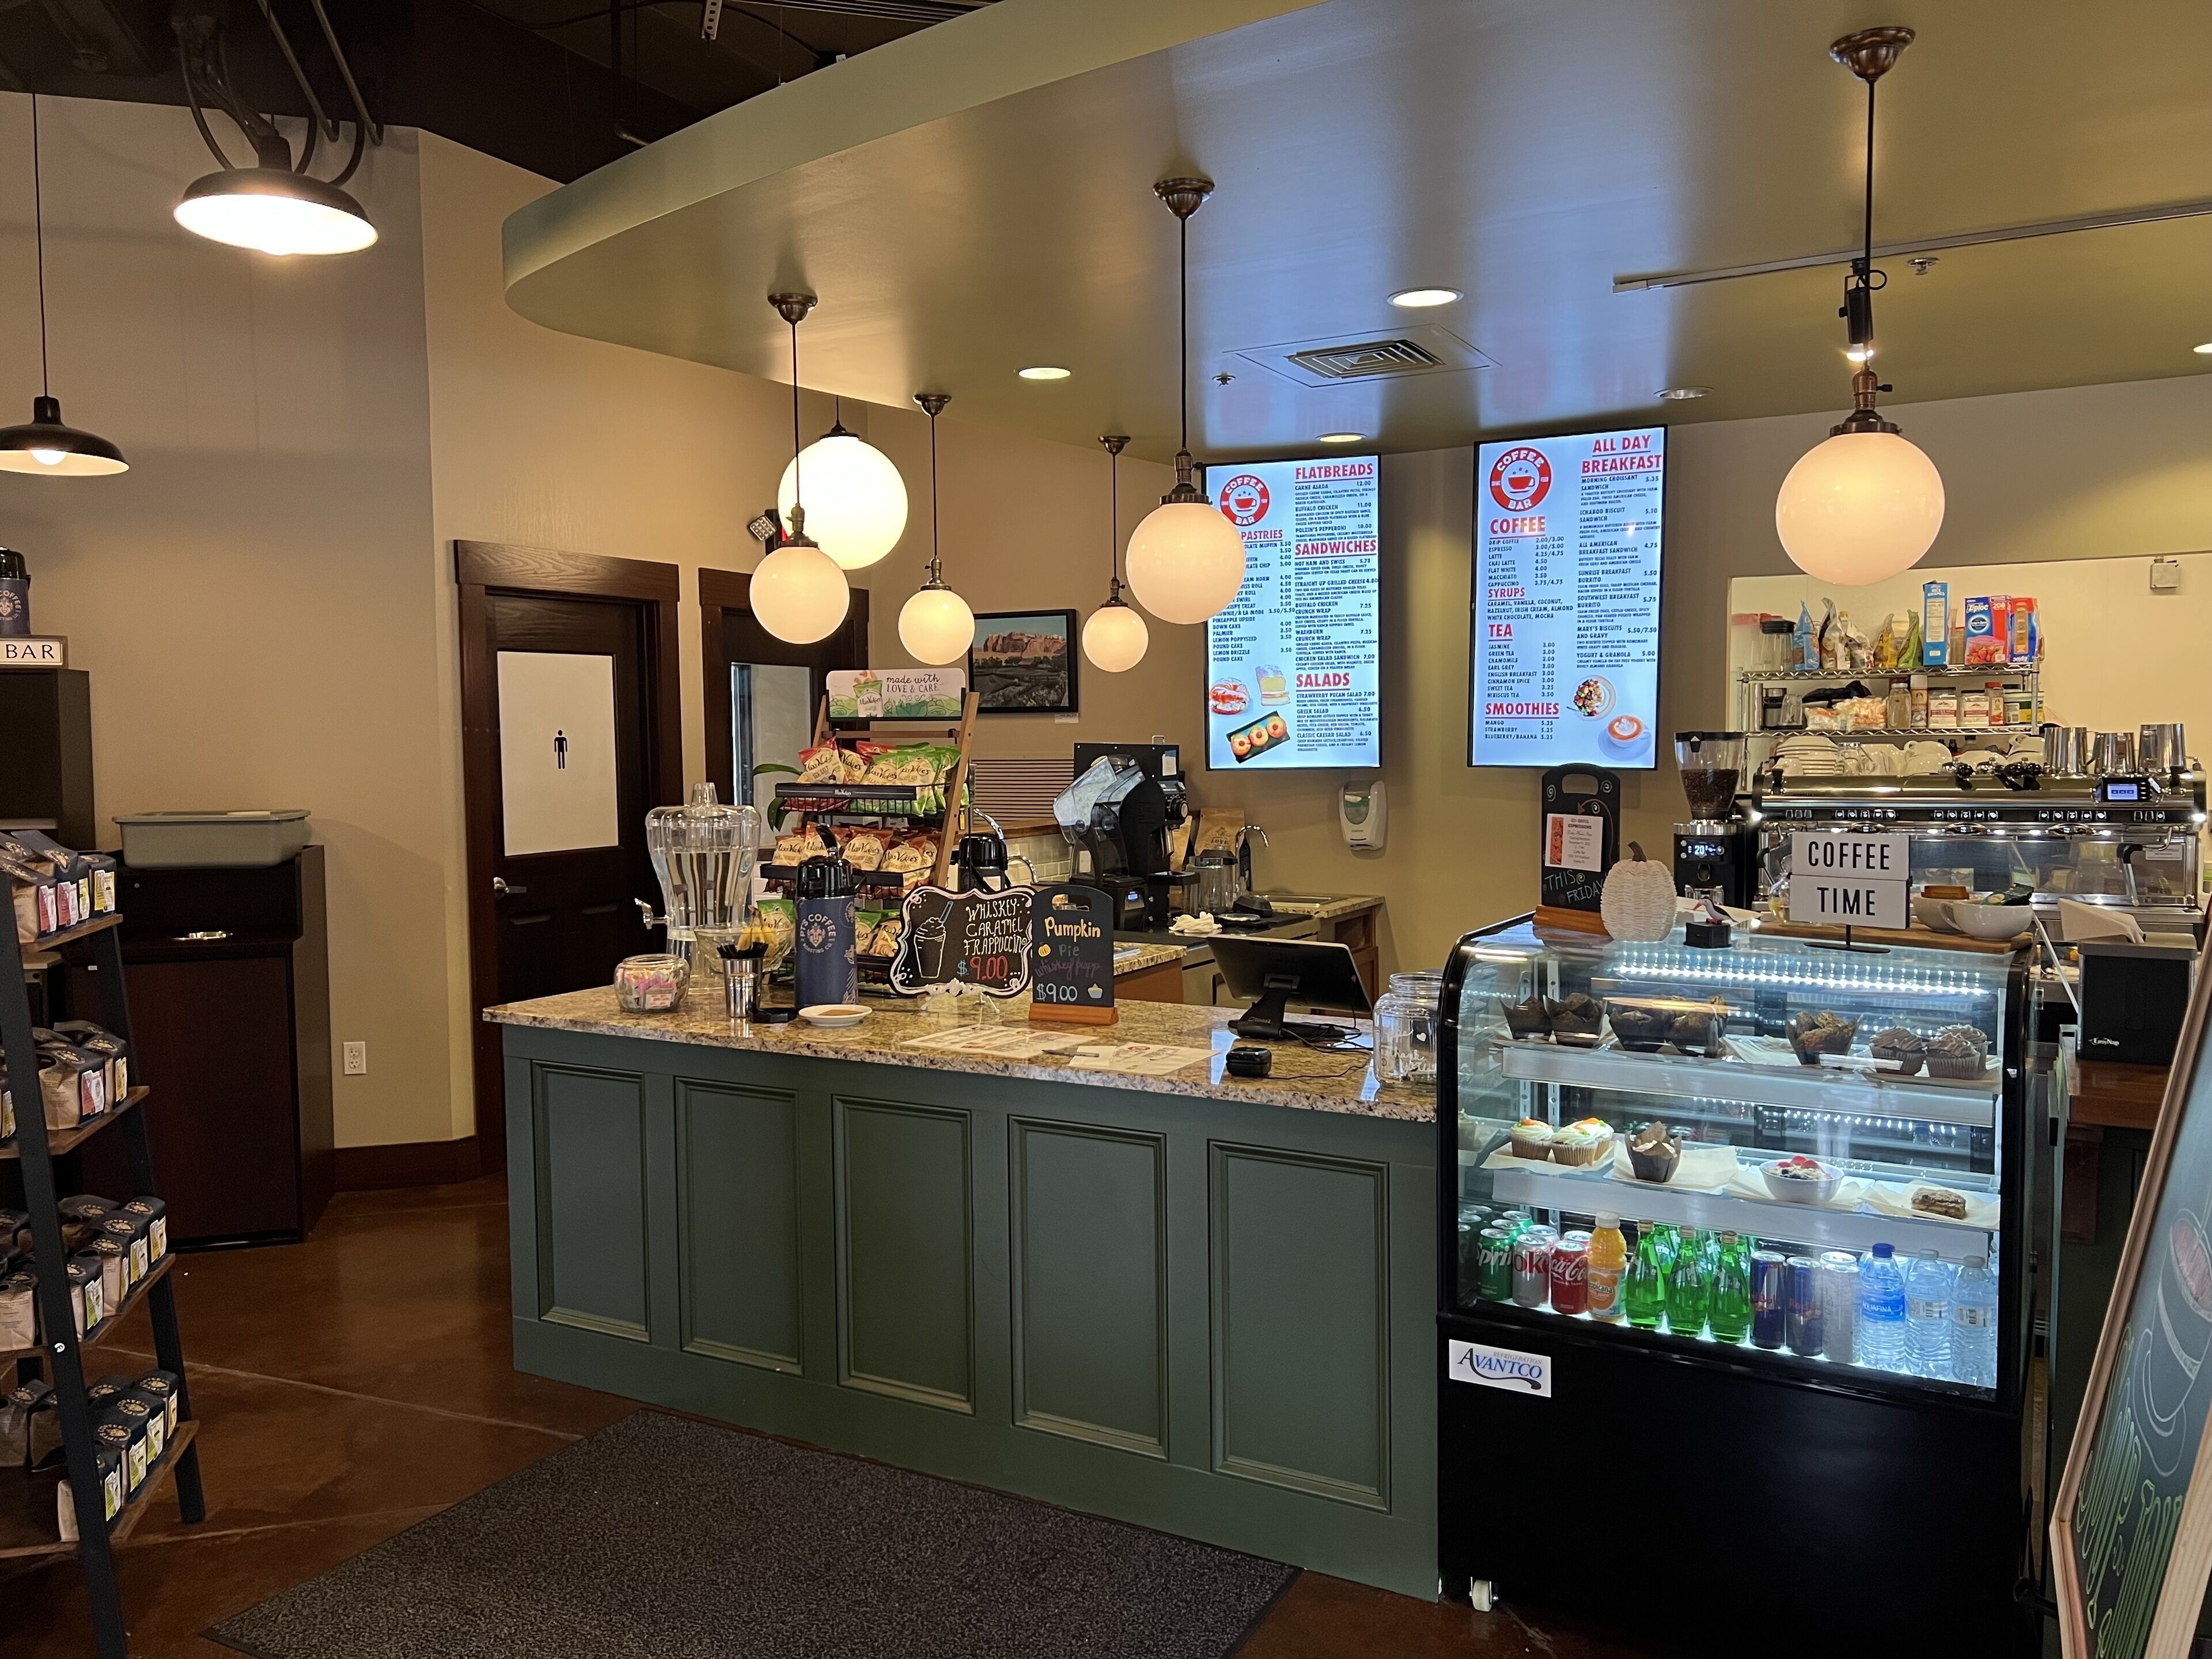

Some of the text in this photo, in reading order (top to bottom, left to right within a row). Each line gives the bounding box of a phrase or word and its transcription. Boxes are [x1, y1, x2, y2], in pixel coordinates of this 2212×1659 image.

[1593, 434, 1652, 453] ALL DAY
[1497, 450, 1545, 471] COFFEE
[1582, 454, 1662, 474] BREAKFAST
[1296, 463, 1373, 479] FLATBREADS
[1225, 476, 1263, 494] COFFEE
[1508, 498, 1532, 510] BAR
[1235, 516, 1255, 525] BAR
[1490, 516, 1546, 535] COFFEE
[1241, 529, 1283, 540] PASTRIES
[1295, 540, 1376, 555] SANDWICHES
[1488, 587, 1525, 598] SYRUPS
[1968, 604, 1989, 612] Ziploc
[1488, 624, 1513, 637] TEA
[6, 644, 54, 658] BAR
[914, 673, 940, 683] with
[1296, 672, 1350, 688] SALADS
[887, 683, 938, 693] LOVE & CARE
[1486, 703, 1559, 715] SMOOTHIES
[1808, 841, 1890, 870] COFFEE
[1544, 870, 1576, 891] THIS
[1566, 879, 1603, 903] FRIDAY
[1817, 887, 1876, 916] TIME
[808, 914, 836, 937] COFFEE
[966, 917, 1023, 937] CARAMEL
[1044, 916, 1101, 942] Pumpkin
[1035, 958, 1075, 980] whiskey
[1036, 983, 1078, 1002] $9.00
[1457, 1348, 1543, 1381] AVANTCO
[1493, 1351, 1544, 1365] REFRIGERATION
